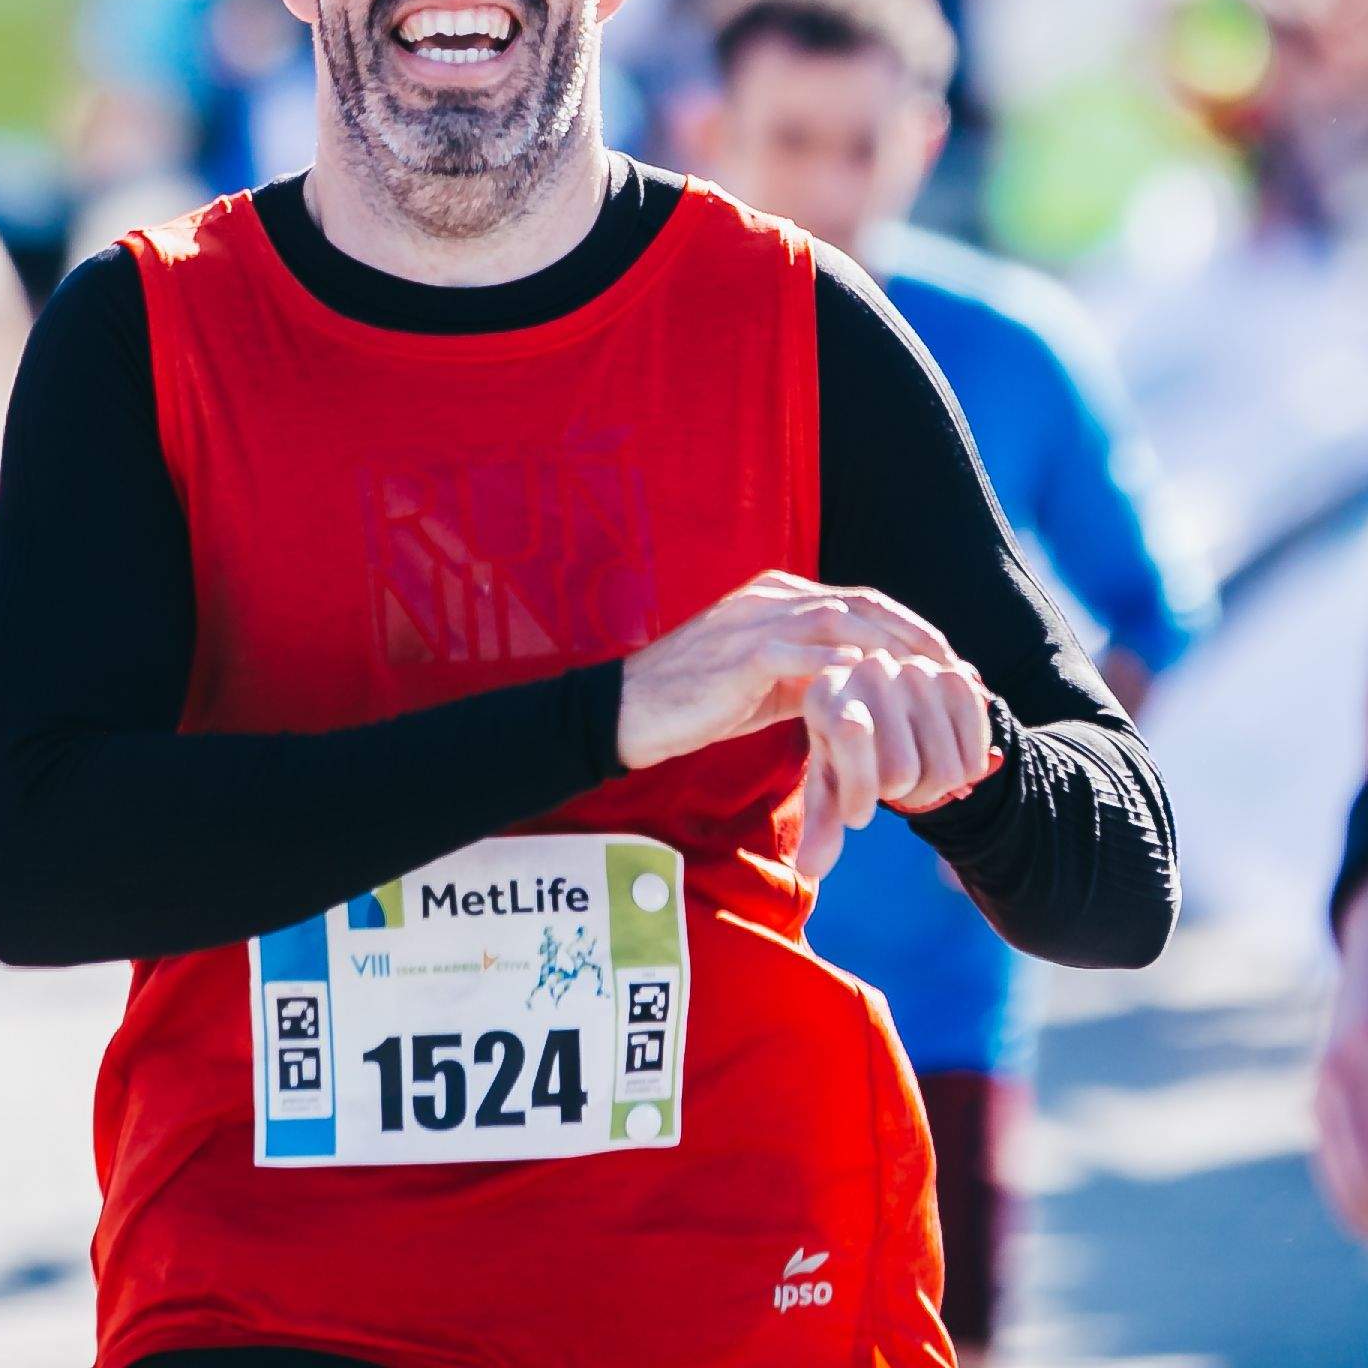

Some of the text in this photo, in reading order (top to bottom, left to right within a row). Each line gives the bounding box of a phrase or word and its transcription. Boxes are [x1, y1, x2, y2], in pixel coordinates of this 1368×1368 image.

[420, 877, 591, 920] MetLife
[350, 953, 392, 978] VIII
[362, 1028, 589, 1132] 1524
